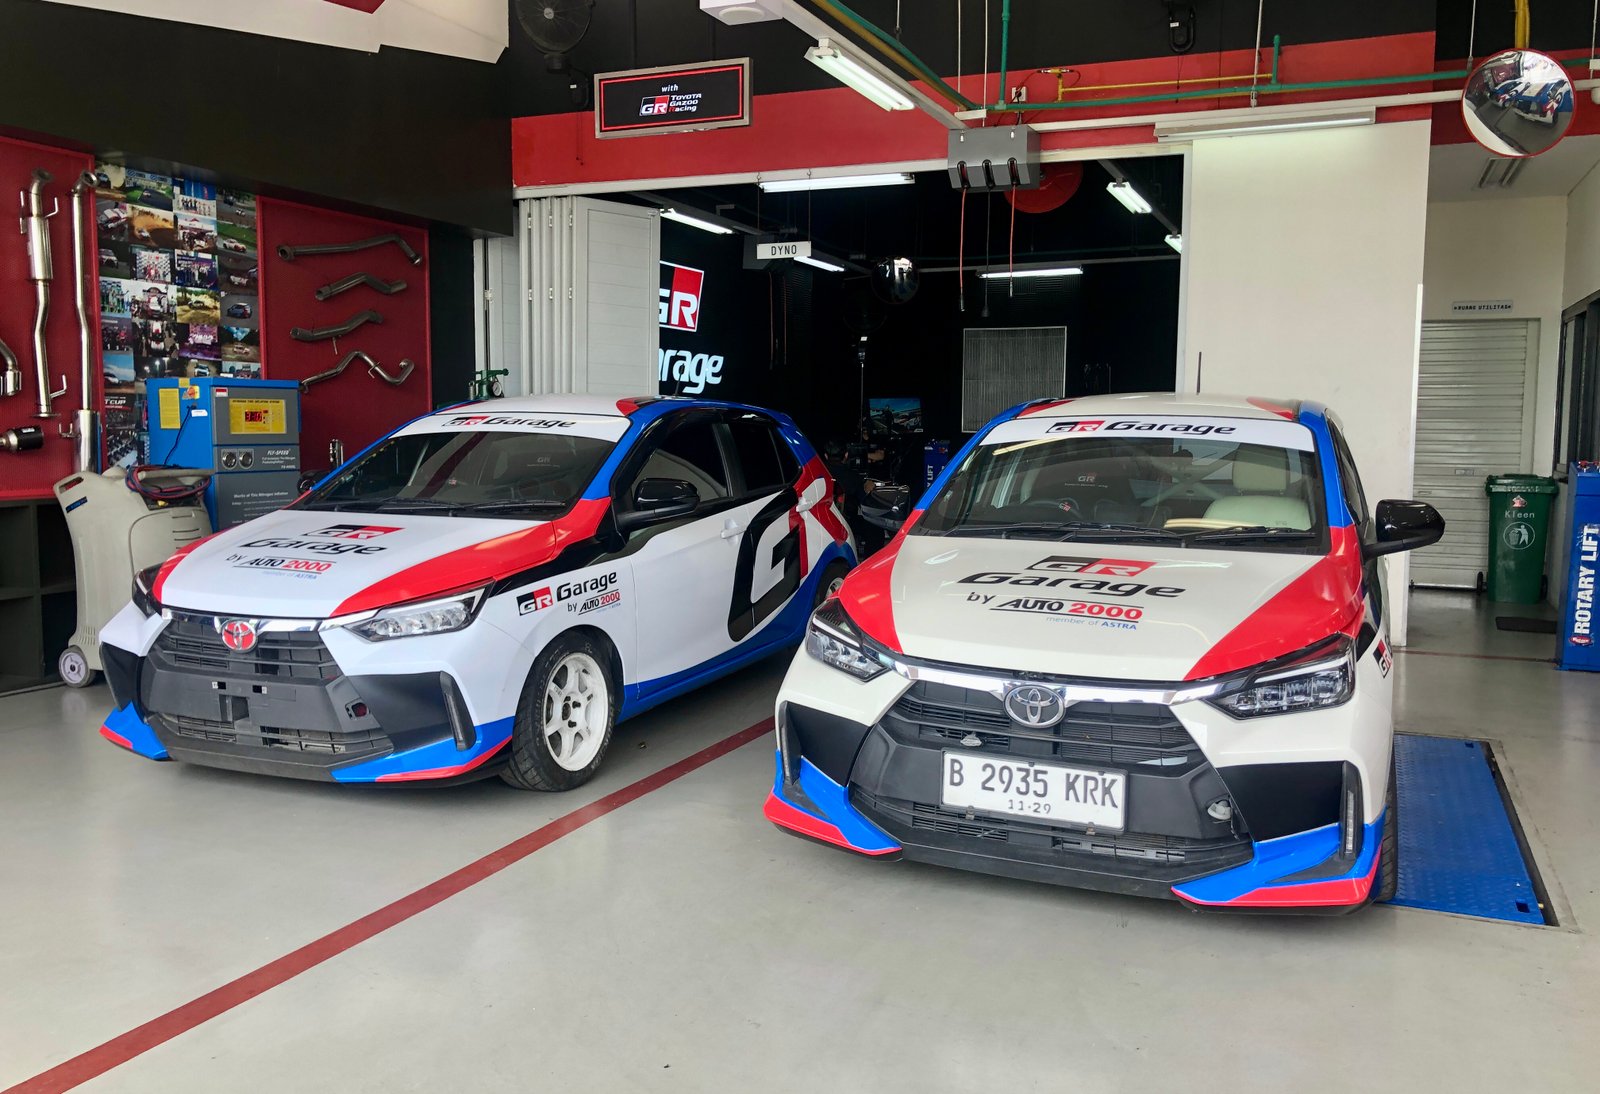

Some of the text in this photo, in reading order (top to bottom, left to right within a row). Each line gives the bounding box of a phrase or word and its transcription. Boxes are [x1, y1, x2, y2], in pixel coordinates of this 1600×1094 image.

[661, 84, 679, 92] with
[669, 99, 699, 107] GAZOO
[671, 93, 702, 101] TOYOTA
[640, 101, 668, 115] GR
[770, 244, 797, 256] DYNO
[444, 416, 577, 428] GR Garage
[1048, 421, 1236, 435] GR Garage
[1078, 475, 1095, 483] GR
[1504, 510, 1535, 519] Kleen
[306, 528, 388, 539] GR
[239, 538, 387, 555] Garage
[1580, 524, 1600, 562] LIFT
[226, 553, 332, 572] by AUTO 2000
[1029, 559, 1142, 576] GR
[957, 572, 1186, 597] Garage
[517, 571, 618, 615] GR Garage
[1573, 565, 1596, 635] ROTARY
[567, 602, 578, 612] by
[579, 598, 600, 613] AUTO
[600, 591, 621, 605] 2000
[966, 592, 1143, 620] by AUTO 2000
[1046, 615, 1137, 630] member of ASTRA
[949, 758, 1118, 809] B 2935 KRK
